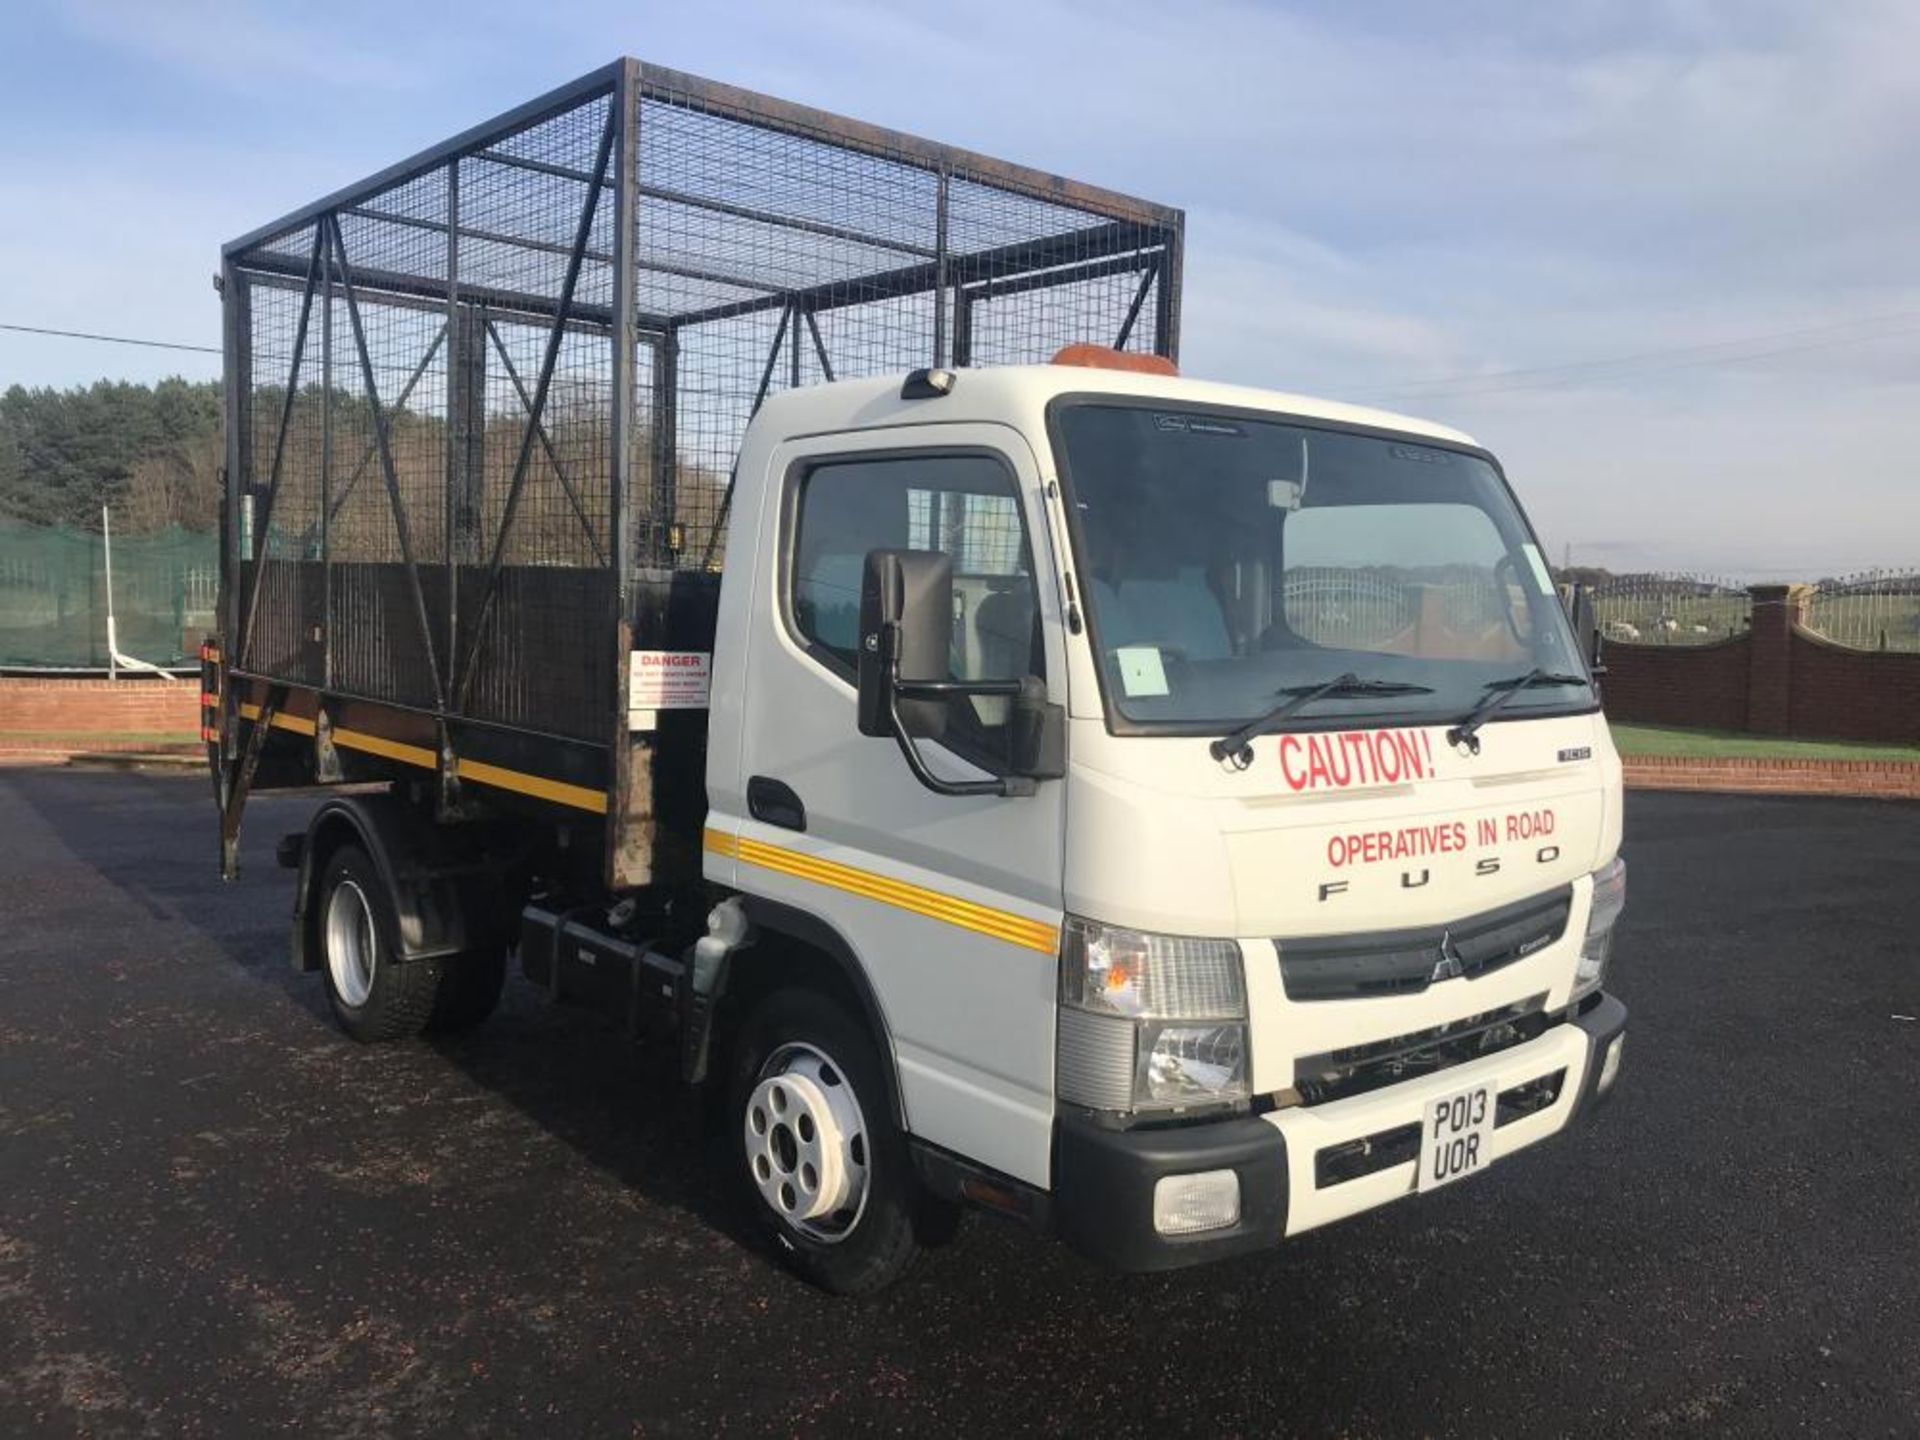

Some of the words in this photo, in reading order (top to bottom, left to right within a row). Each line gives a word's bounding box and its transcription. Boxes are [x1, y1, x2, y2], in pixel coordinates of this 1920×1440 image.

[641, 655, 702, 667] DANGER
[1279, 729, 1436, 792] CAUTION!
[1328, 822, 1467, 867] OPERATIVES
[1478, 818, 1498, 846] IN
[1506, 809, 1556, 841] ROAD
[1318, 846, 1560, 901] FUSO
[1434, 1132, 1480, 1180] UOR
